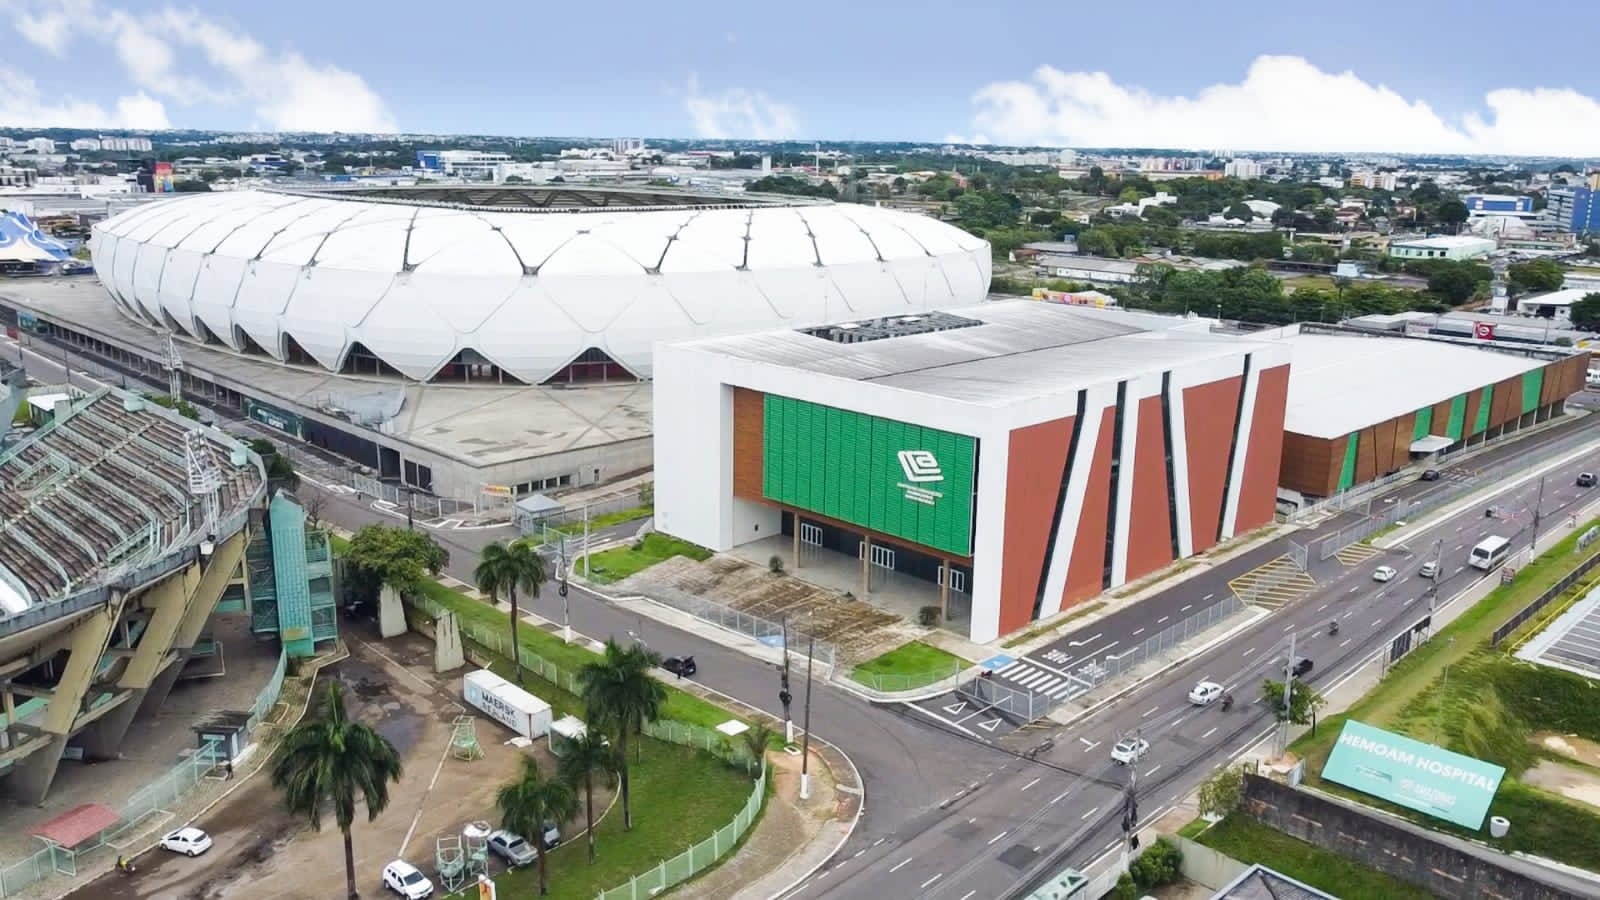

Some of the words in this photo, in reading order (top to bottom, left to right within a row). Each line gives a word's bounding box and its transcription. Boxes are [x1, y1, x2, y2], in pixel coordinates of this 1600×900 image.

[482, 691, 515, 715] MAERSK
[1339, 732, 1415, 766] HEMOAM
[1415, 758, 1496, 793] HOSPITAL
